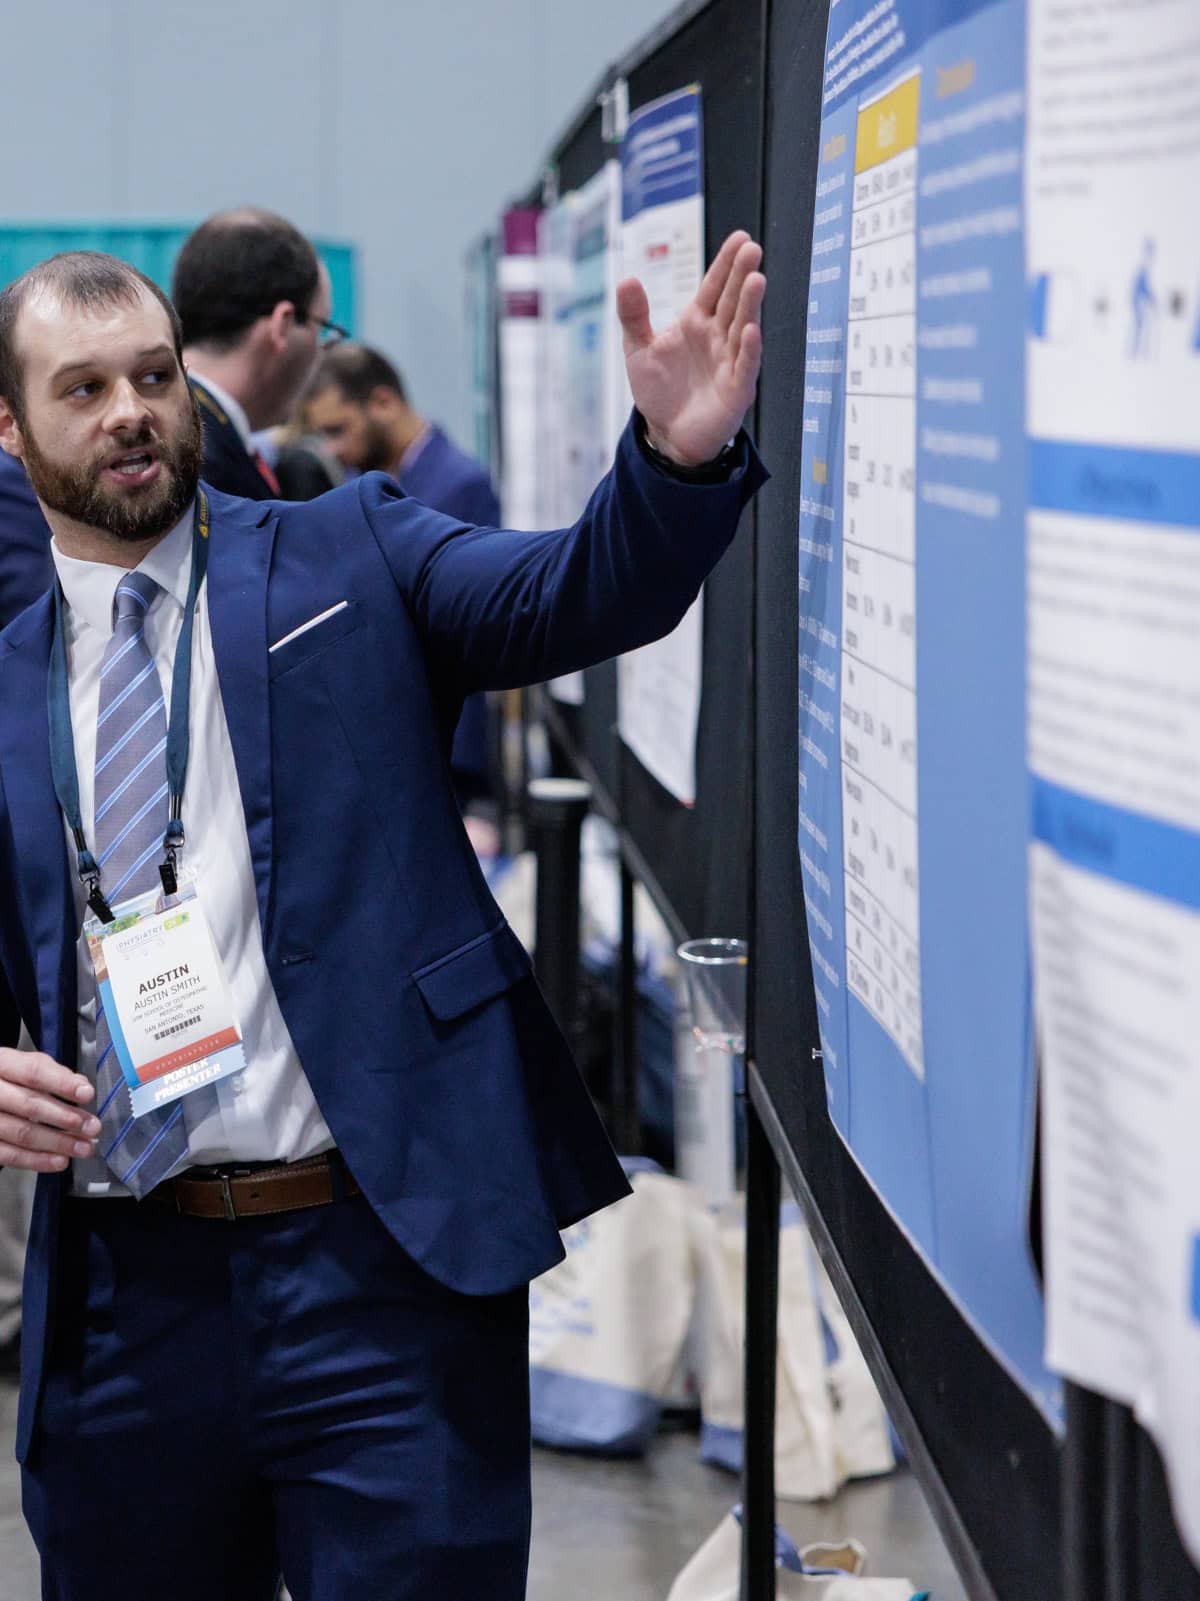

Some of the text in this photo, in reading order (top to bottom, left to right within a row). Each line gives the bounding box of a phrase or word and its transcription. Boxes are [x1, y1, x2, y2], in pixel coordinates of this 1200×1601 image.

[134, 976, 200, 1010] AUSTIN SMITH
[139, 964, 190, 994] AUSTIN
[144, 1024, 156, 1033] SAN
[187, 1004, 204, 1014] TEXAS
[162, 1058, 208, 1085] POSTER
